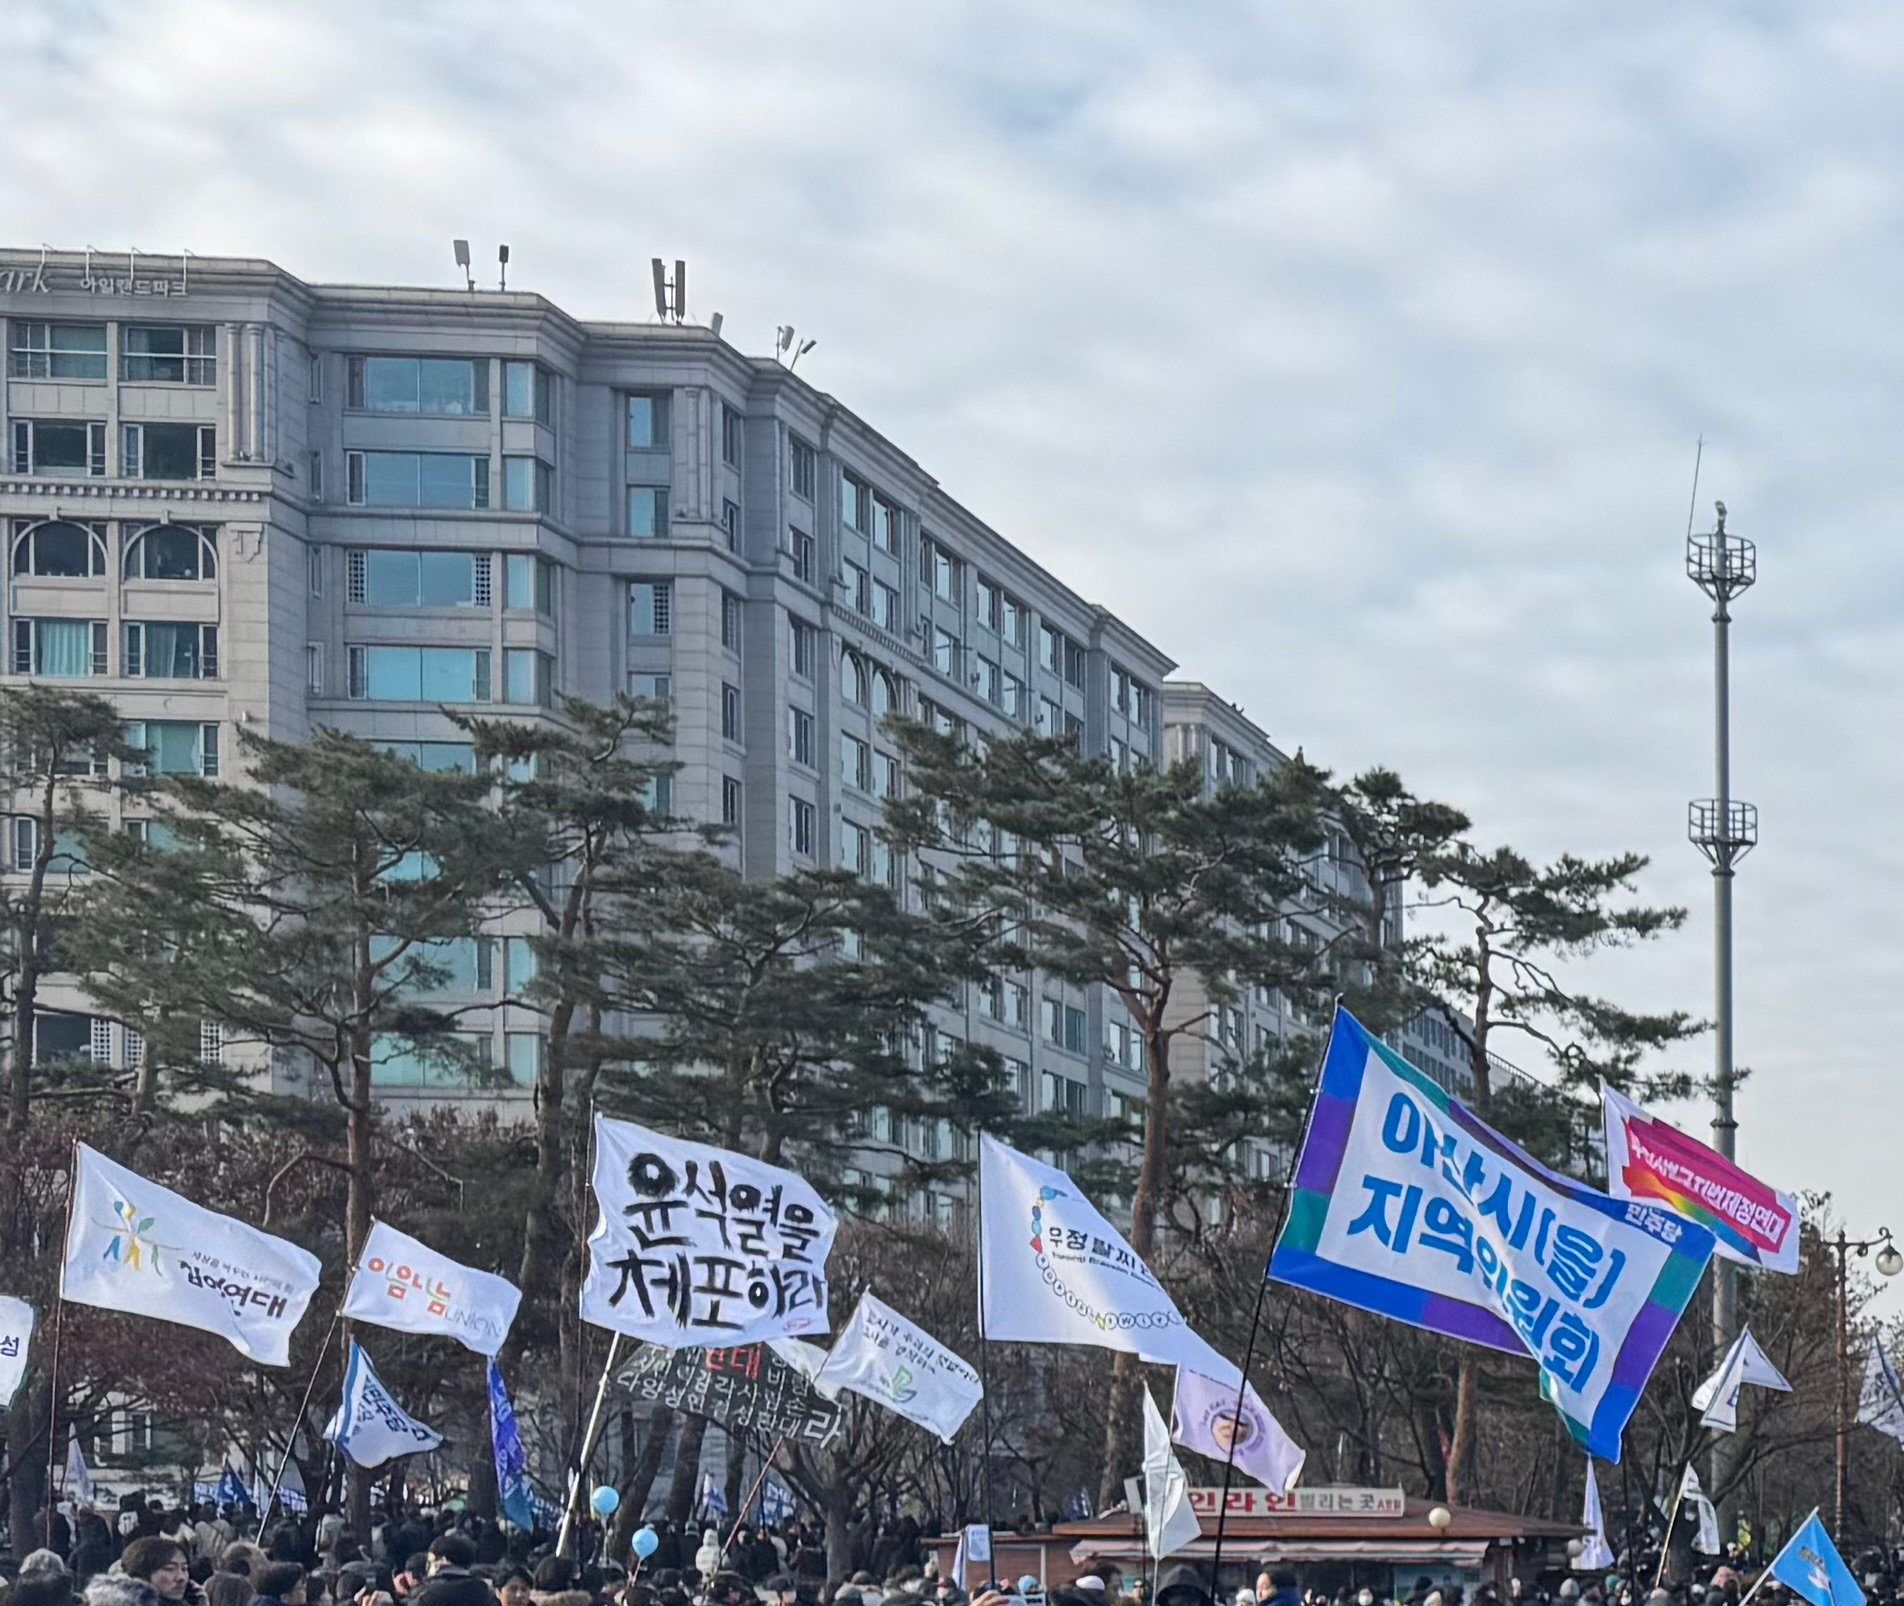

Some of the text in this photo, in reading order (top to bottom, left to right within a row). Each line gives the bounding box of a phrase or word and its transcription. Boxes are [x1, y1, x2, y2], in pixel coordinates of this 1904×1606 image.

[80, 277, 187, 297] 아일랜드파크
[624, 1153, 820, 1264] 윤석열을
[1382, 1092, 1626, 1309] 아산시(을)
[1625, 1203, 1683, 1243] 민주당
[605, 1249, 829, 1328] 체포하라
[1347, 1174, 1599, 1393] 지역위원회
